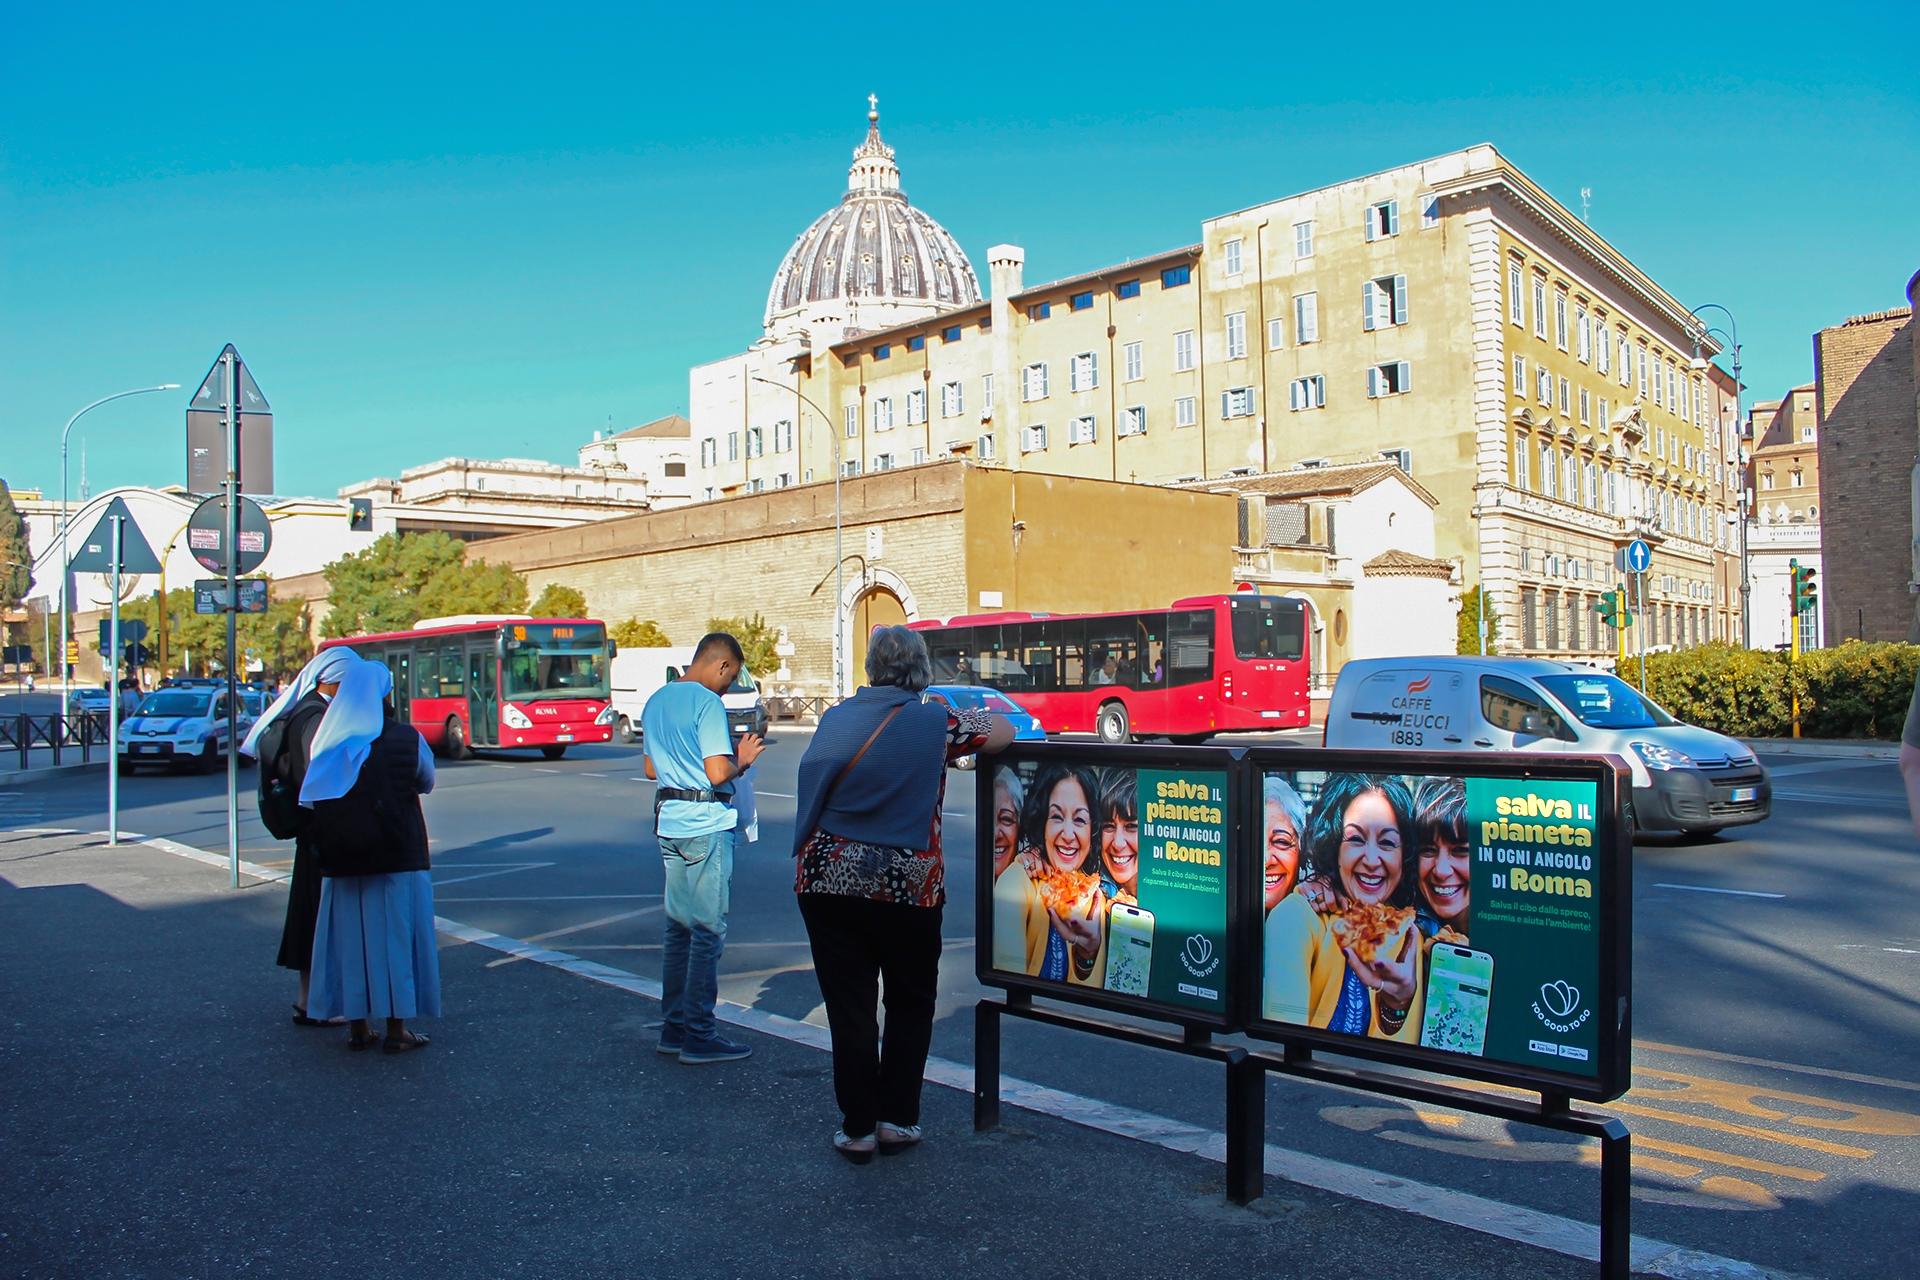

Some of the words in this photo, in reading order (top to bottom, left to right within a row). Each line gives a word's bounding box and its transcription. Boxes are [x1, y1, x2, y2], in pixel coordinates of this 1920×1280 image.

[1391, 731, 1424, 746] 1883
[1156, 779, 1209, 801] salva
[1212, 788, 1222, 801] IL
[1146, 799, 1222, 824] pianeta
[1495, 793, 1573, 819] salva
[1577, 803, 1592, 820] IL
[1144, 823, 1154, 837] IN
[1156, 825, 1180, 839] OGNI
[1182, 827, 1221, 844] ANGOLO
[1481, 817, 1592, 847] pianeta
[1153, 845, 1163, 859] DI
[1165, 841, 1221, 867] Roma
[1478, 846, 1493, 862] IN
[1497, 848, 1531, 865] OGNI
[1534, 851, 1592, 871] ANGOLO
[1143, 878, 1169, 887] risparmia
[1151, 868, 1167, 876] Salva
[1171, 870, 1184, 878] cibo
[1184, 872, 1198, 880] dallo
[1492, 873, 1506, 889] DI
[1510, 867, 1592, 898] Roma
[1477, 911, 1515, 922] risparmia
[1523, 915, 1545, 926] aiuta
[1490, 900, 1512, 910] Salva
[1520, 903, 1538, 912] cibo
[1538, 904, 1559, 915] dallo
[1560, 908, 1591, 920] spreco,
[1531, 1001, 1545, 1020] TOO
[1544, 1019, 1569, 1033] GOOD
[1568, 1020, 1580, 1030] TO
[1579, 1009, 1590, 1022] GO
